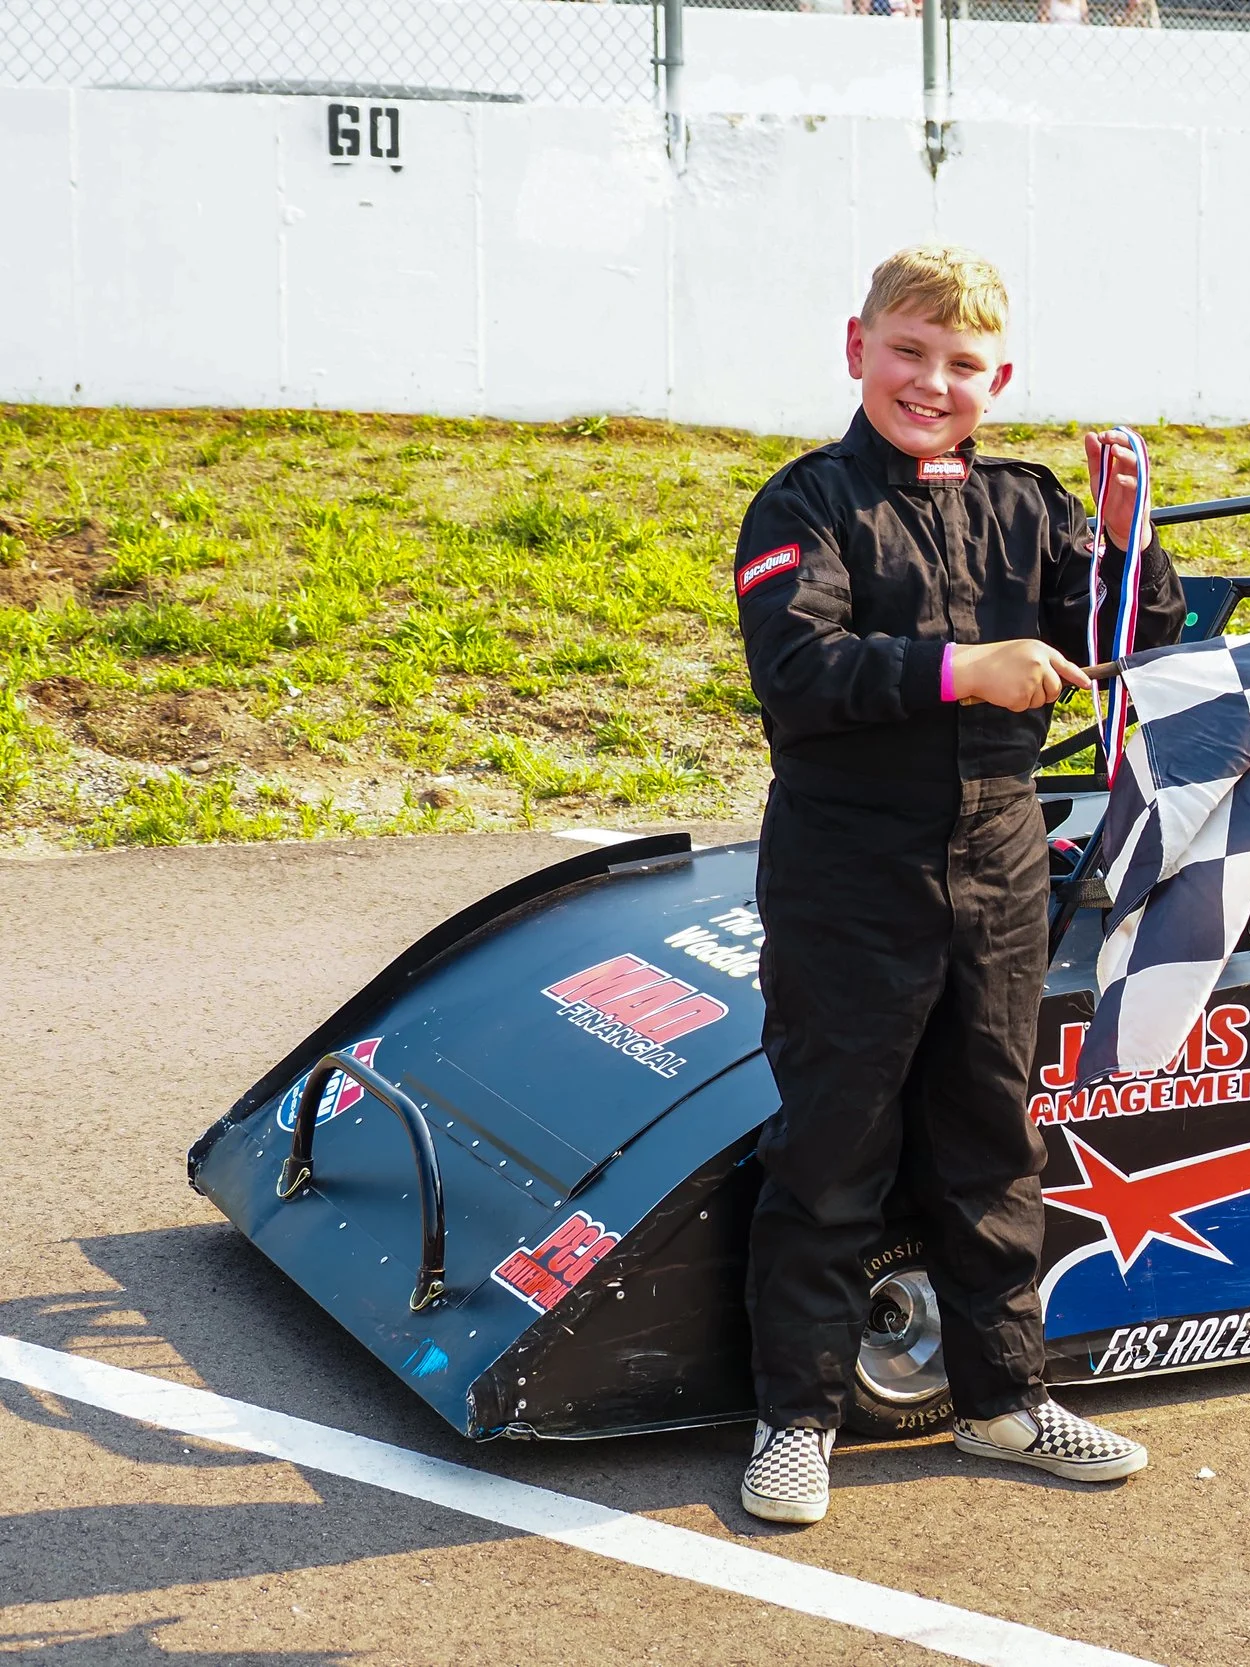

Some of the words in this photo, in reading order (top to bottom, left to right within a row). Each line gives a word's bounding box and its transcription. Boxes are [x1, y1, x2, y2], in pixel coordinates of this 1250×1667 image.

[742, 551, 792, 586] RaceQuip
[543, 954, 728, 1044] MAD
[557, 1001, 687, 1078] FINANCIAL
